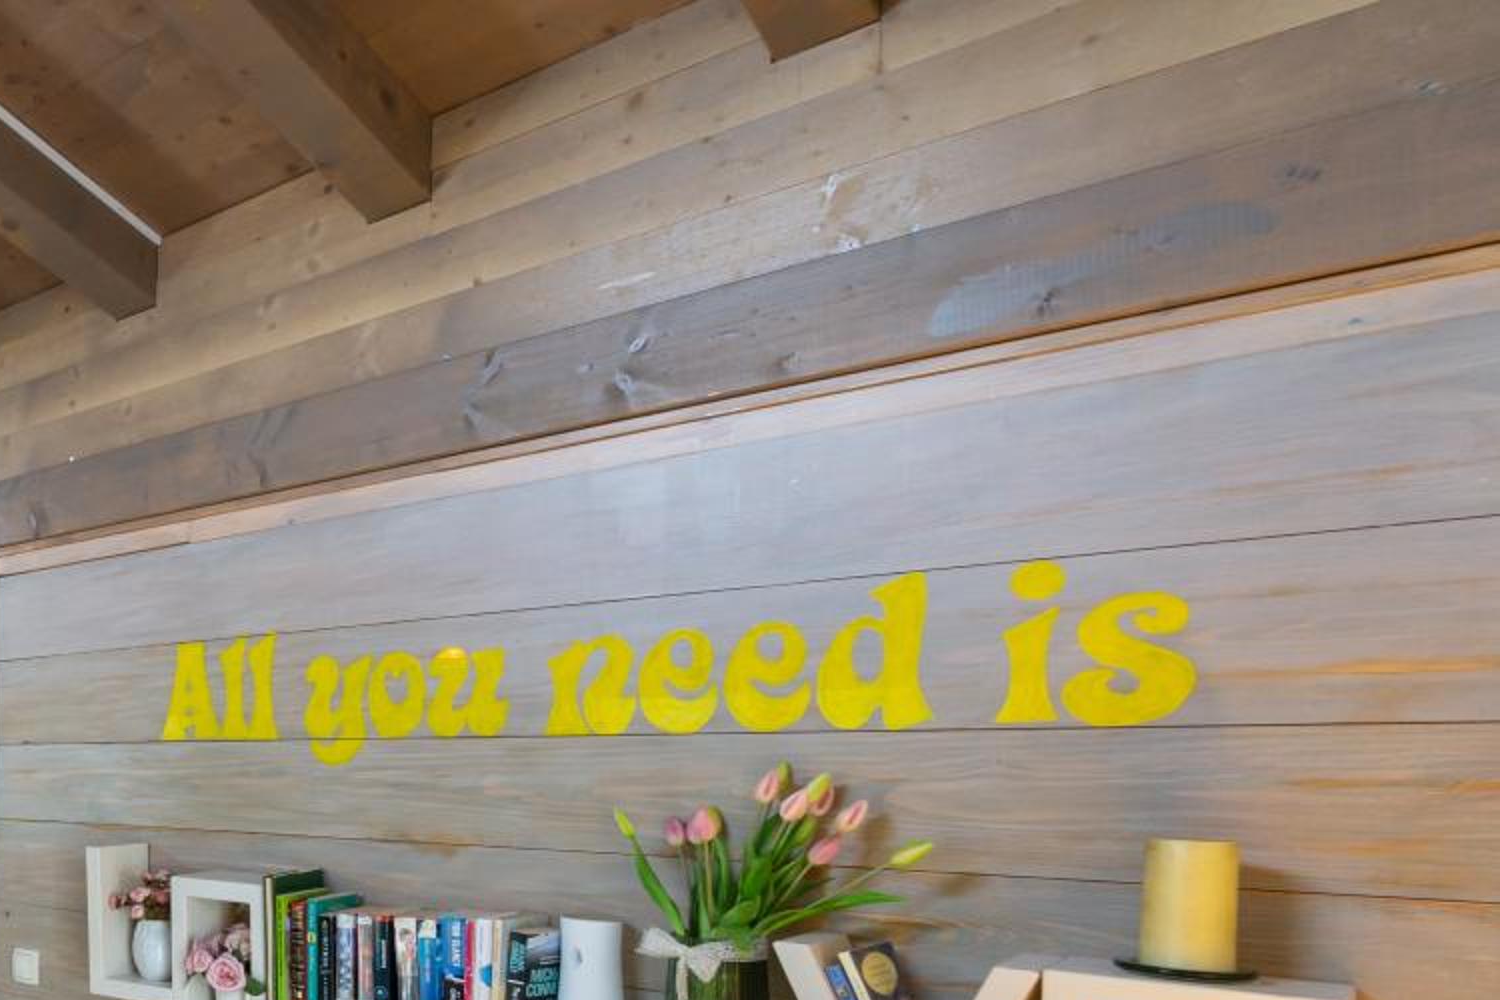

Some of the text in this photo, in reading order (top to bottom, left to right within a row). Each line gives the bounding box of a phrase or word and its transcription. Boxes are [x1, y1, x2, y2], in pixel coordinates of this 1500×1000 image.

[161, 560, 1197, 765] All you need is
